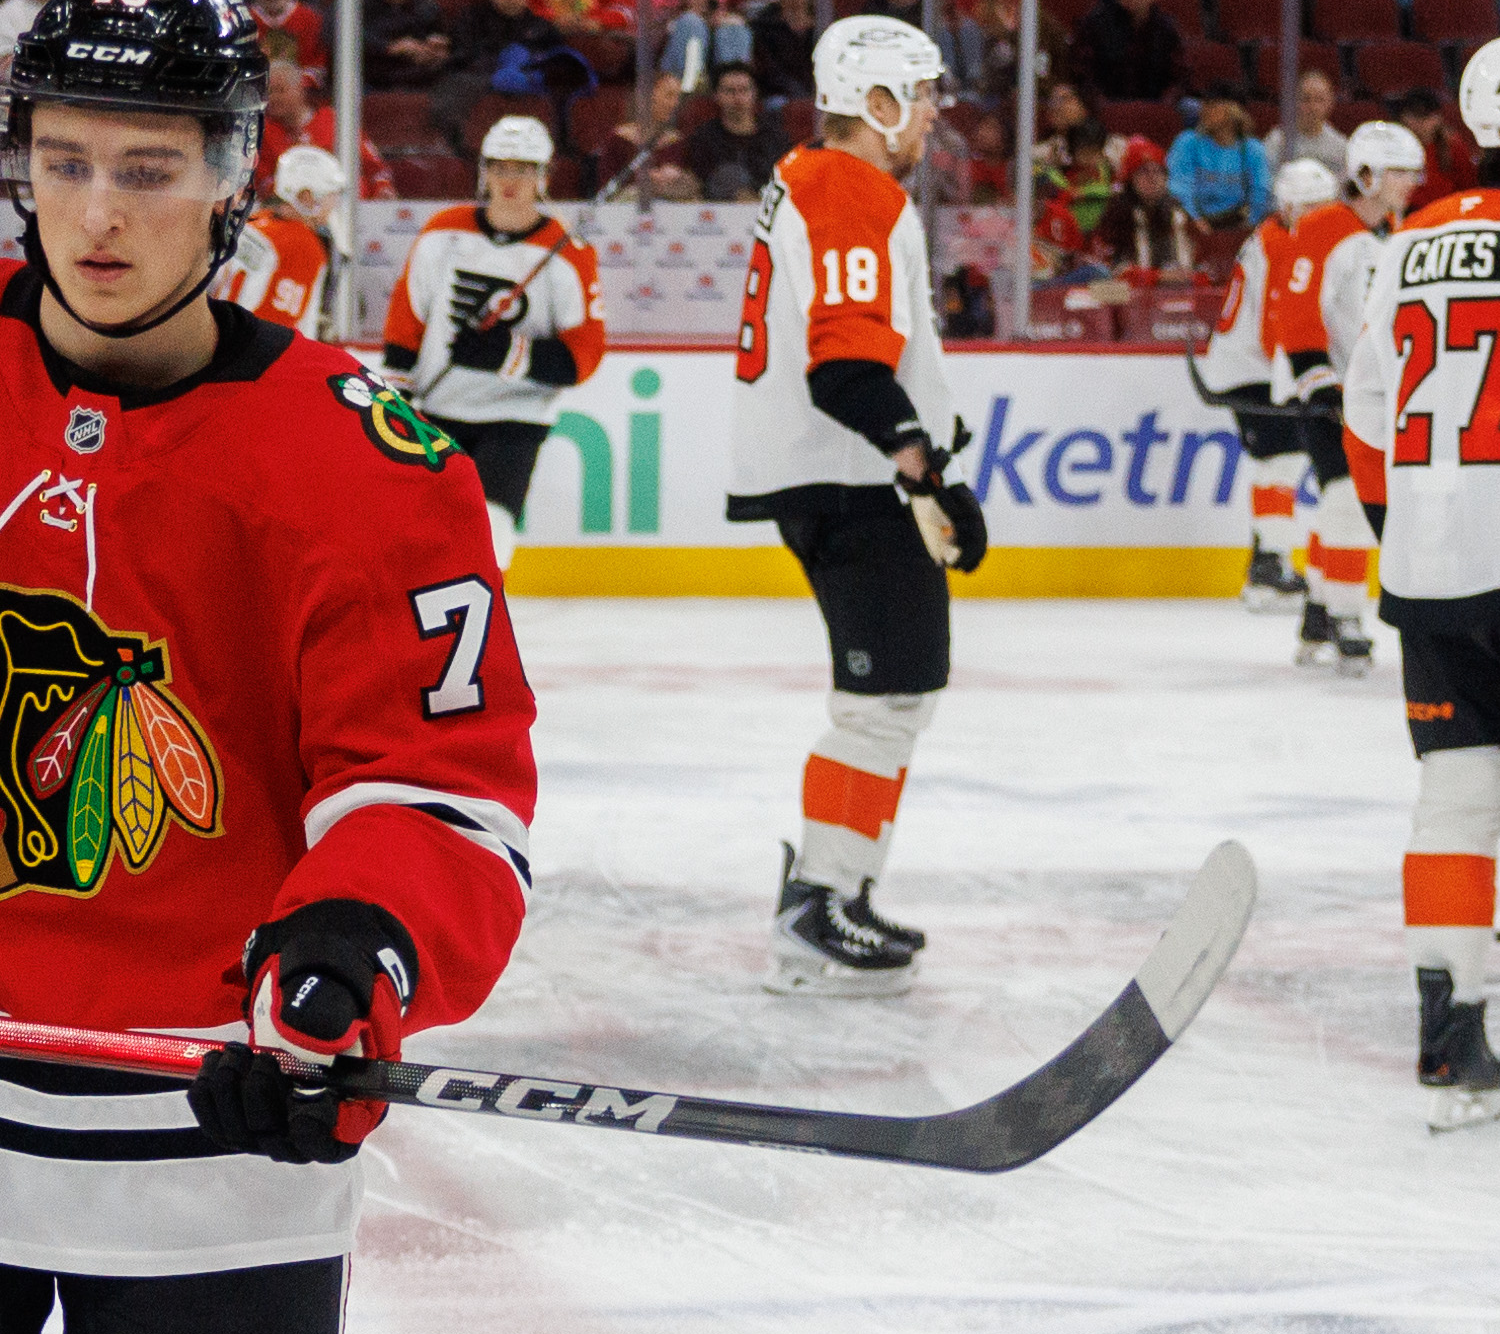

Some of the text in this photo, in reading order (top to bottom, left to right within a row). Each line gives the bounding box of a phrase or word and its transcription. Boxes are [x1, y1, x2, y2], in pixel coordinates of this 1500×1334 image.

[66, 42, 151, 65] CCM
[823, 246, 880, 306] 18
[1405, 233, 1497, 283] CATES
[72, 422, 100, 444] NHL
[407, 572, 495, 721] 7
[290, 975, 319, 1009] CCM
[415, 1068, 680, 1134] CCM
